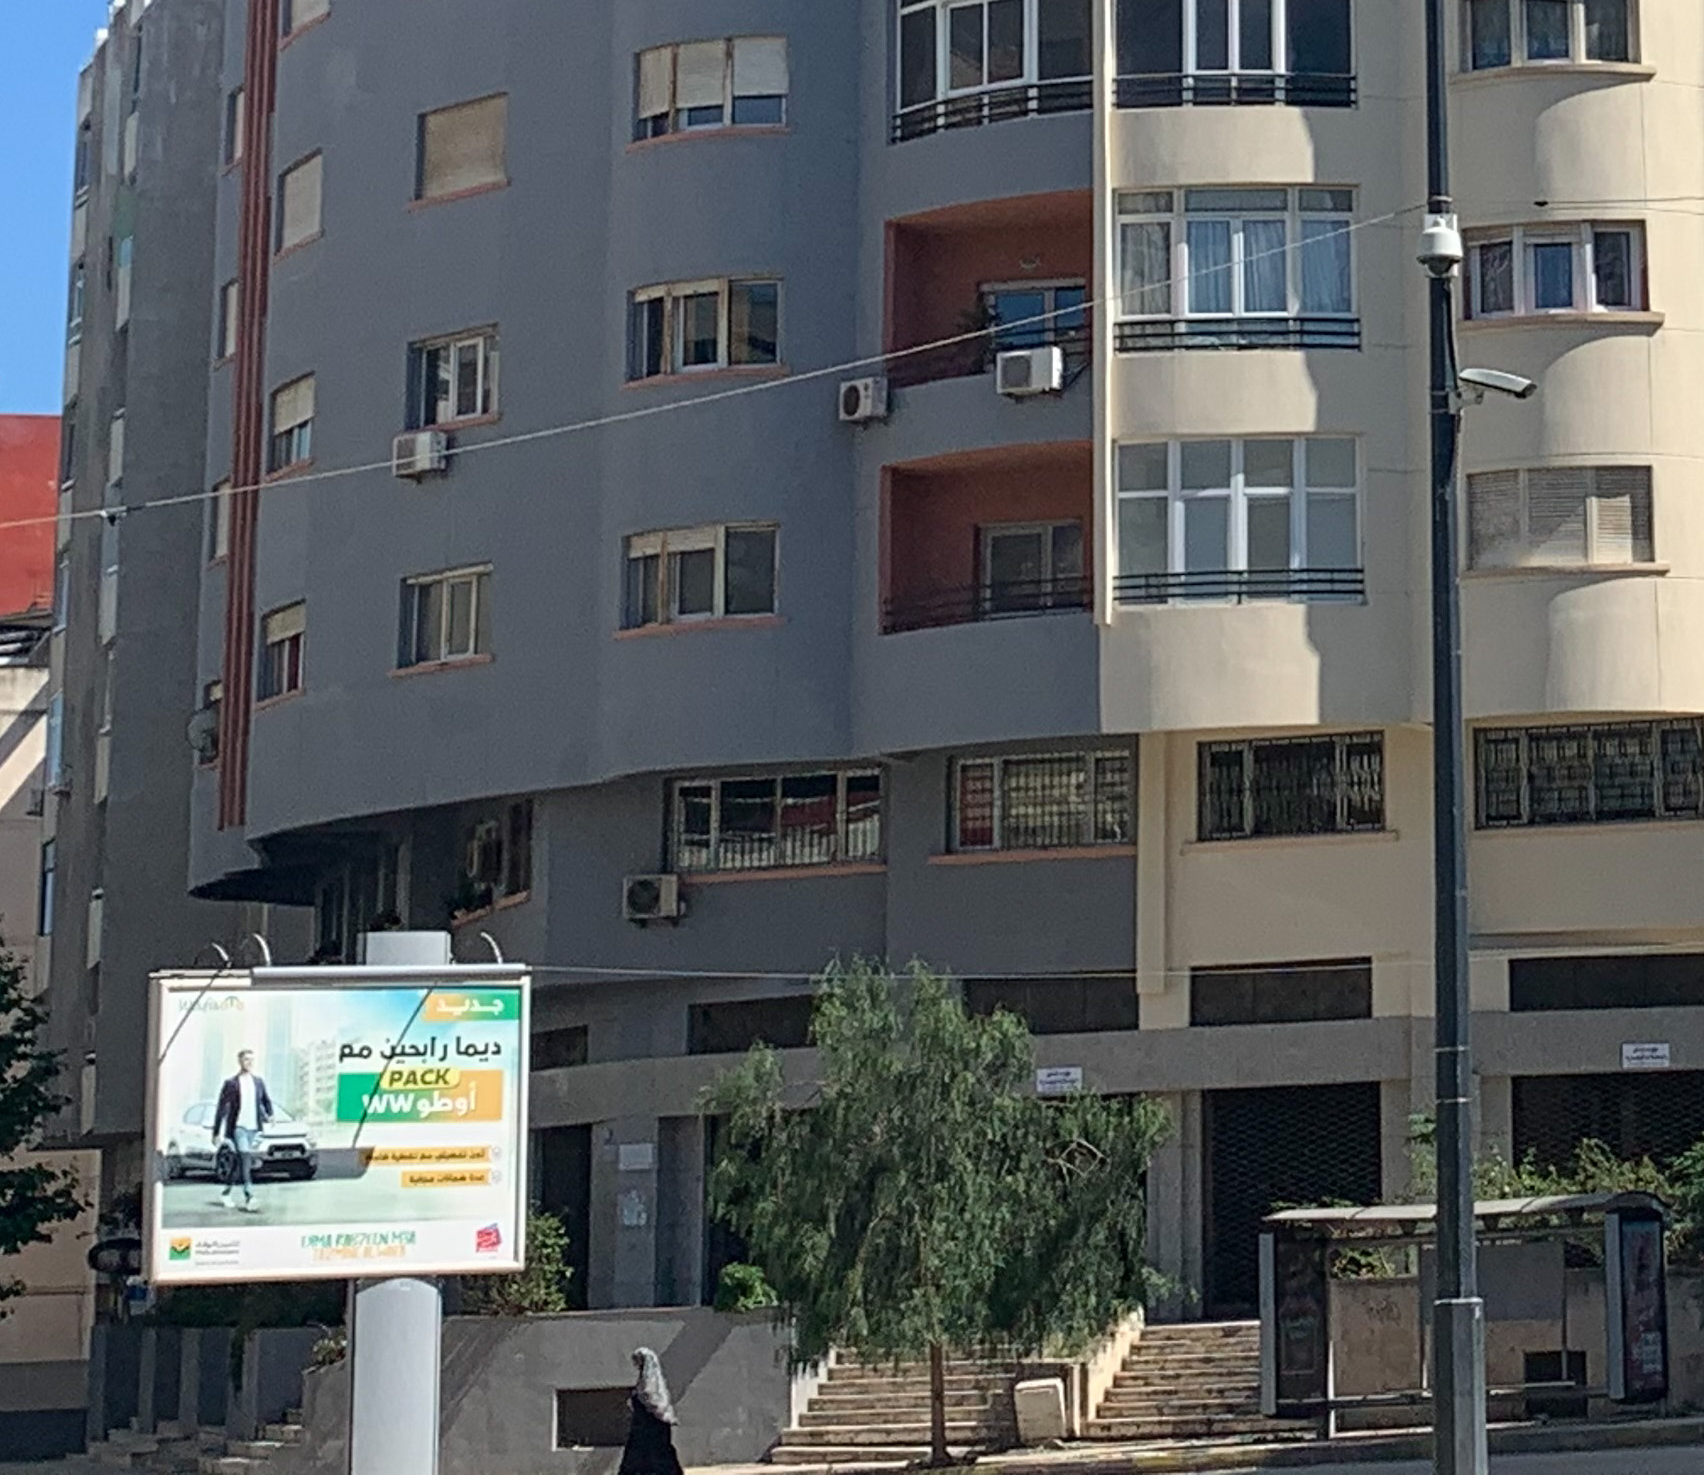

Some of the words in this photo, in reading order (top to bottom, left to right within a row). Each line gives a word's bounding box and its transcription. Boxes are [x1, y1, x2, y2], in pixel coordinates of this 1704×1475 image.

[380, 1035, 448, 1065] رابحين
[456, 1035, 502, 1063] ديما
[388, 1067, 451, 1087] PACK
[361, 1093, 415, 1115] WW
